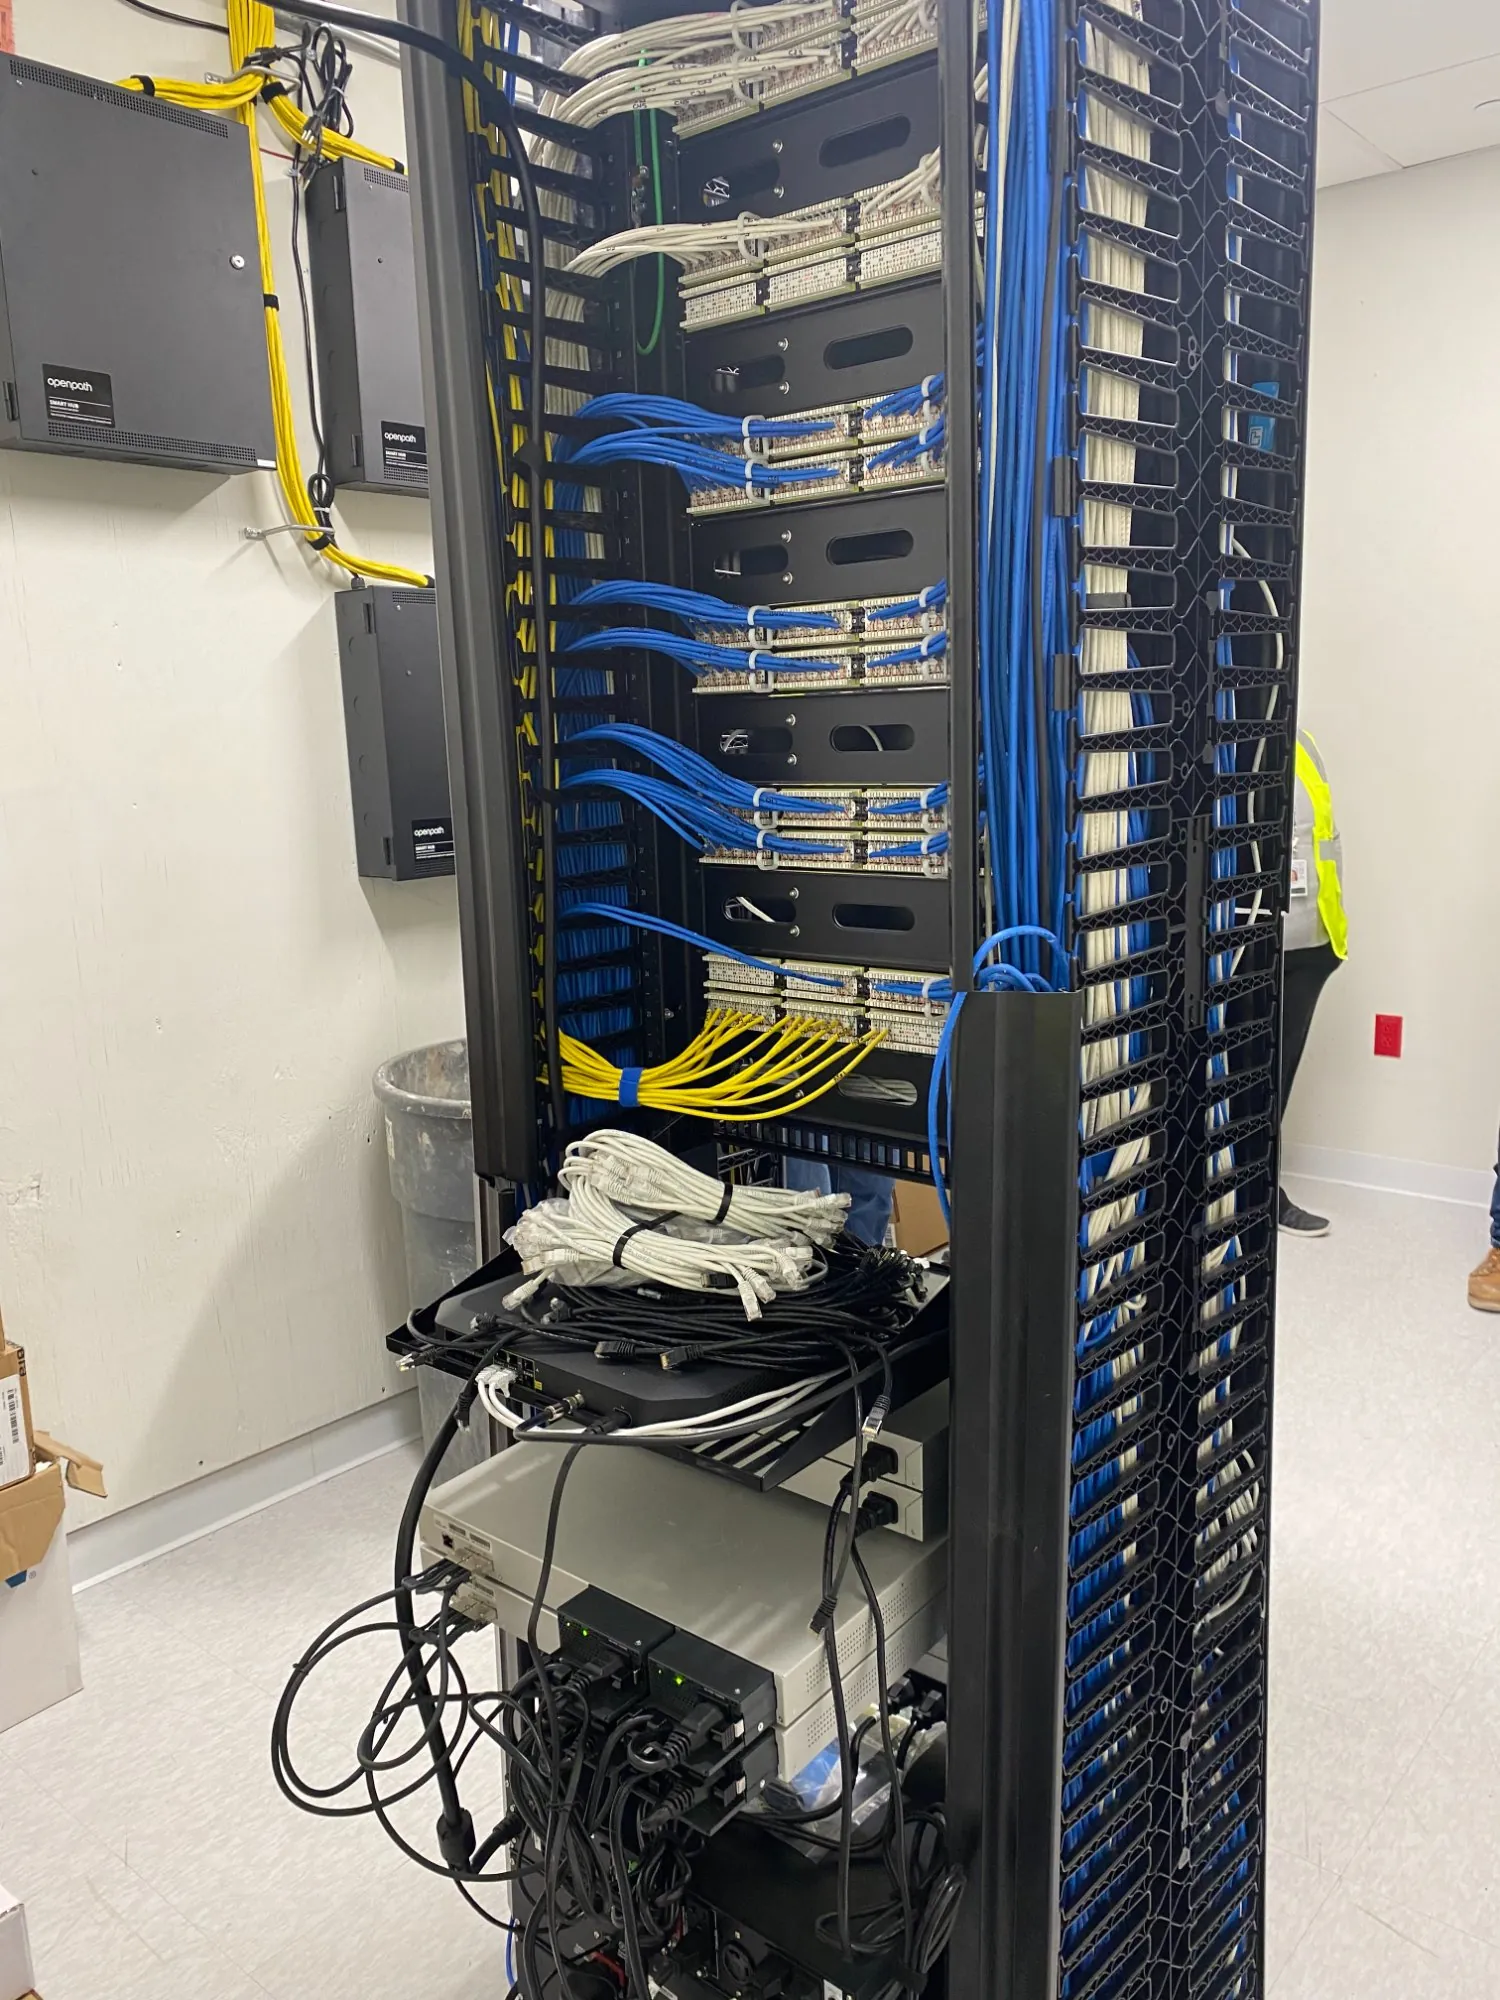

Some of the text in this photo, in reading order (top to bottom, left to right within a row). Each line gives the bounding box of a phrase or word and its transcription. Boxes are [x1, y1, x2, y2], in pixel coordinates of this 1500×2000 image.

[47, 377, 93, 392] openpath
[384, 432, 416, 443] openpath
[414, 826, 445, 837] openpath
